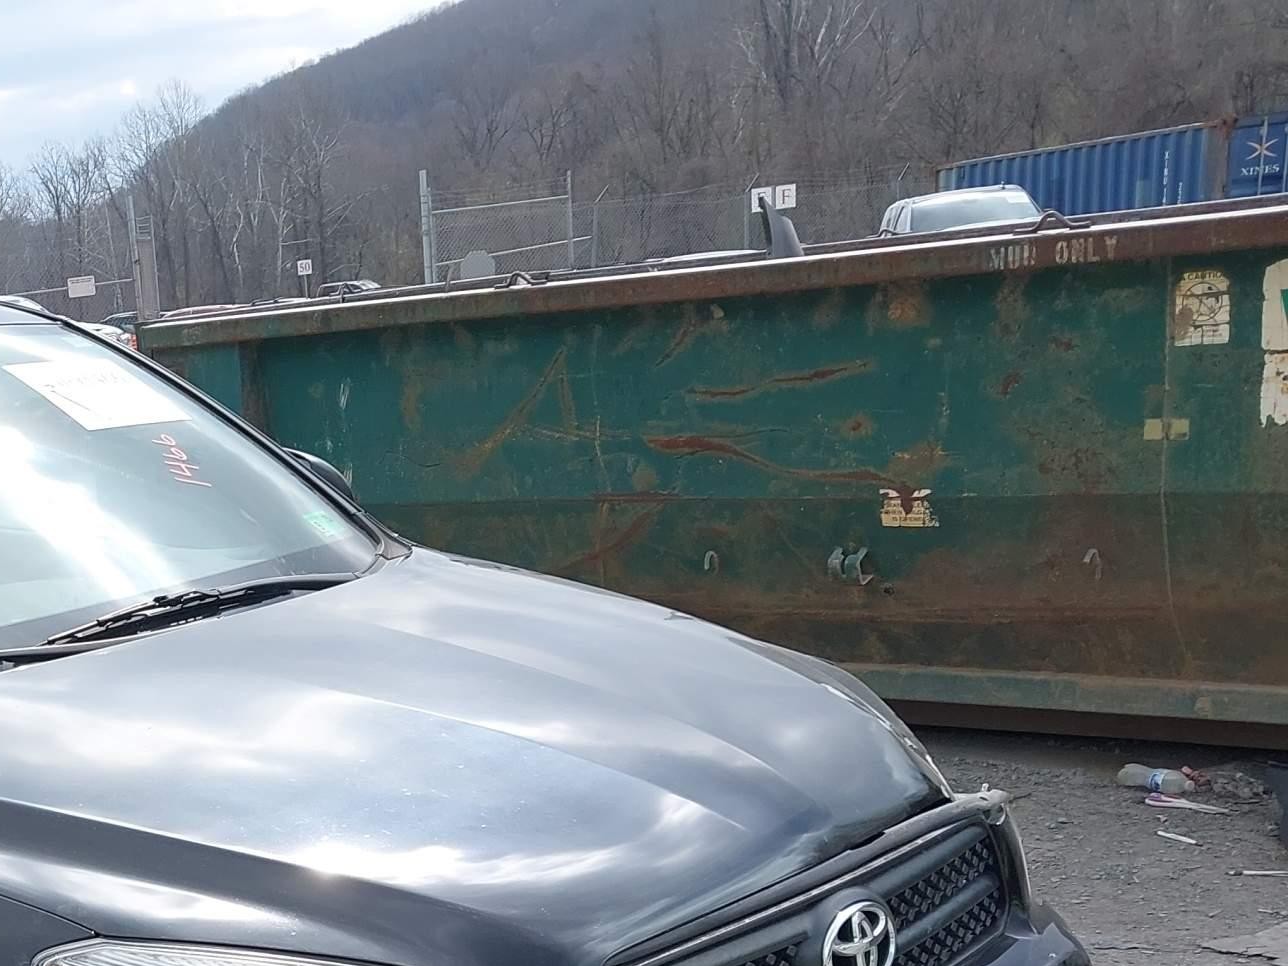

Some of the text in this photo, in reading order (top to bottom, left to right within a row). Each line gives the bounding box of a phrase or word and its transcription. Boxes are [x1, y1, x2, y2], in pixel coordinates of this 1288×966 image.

[781, 189, 792, 205] F
[1055, 235, 1118, 265] ONLY
[1187, 271, 1224, 281] CAUTIO
[151, 433, 213, 488] 1466
